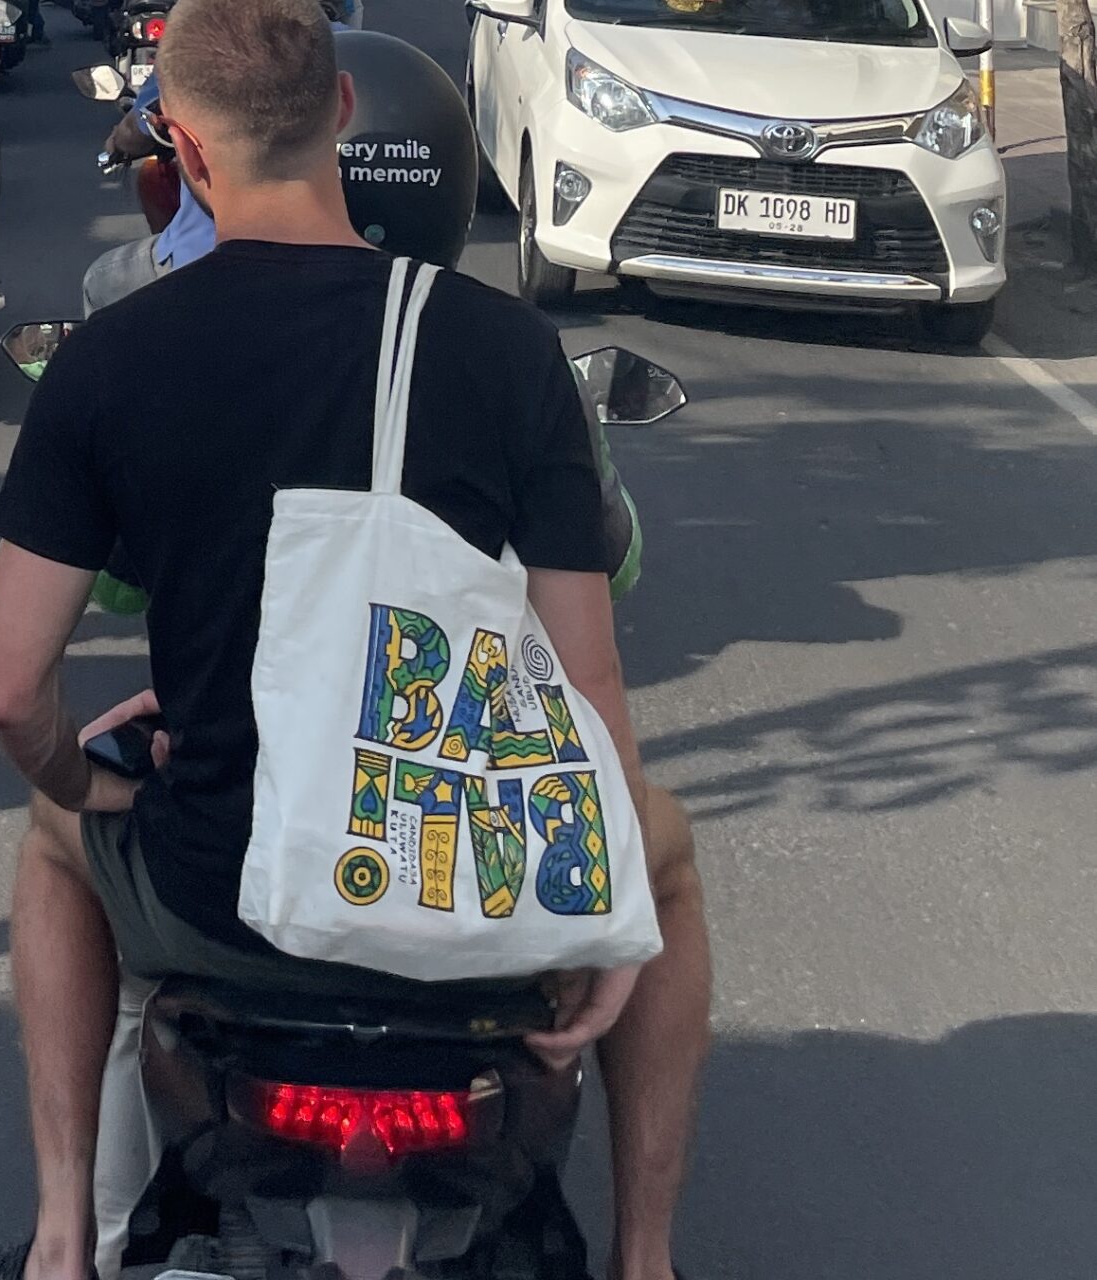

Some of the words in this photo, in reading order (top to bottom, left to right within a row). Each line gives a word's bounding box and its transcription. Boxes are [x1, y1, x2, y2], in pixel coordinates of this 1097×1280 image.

[384, 139, 431, 160] mile
[349, 166, 442, 187] memory
[724, 193, 749, 217] DK
[760, 196, 811, 221] 1098
[825, 201, 851, 225] HD
[354, 602, 591, 771] BALI
[390, 809, 399, 855] KUTA
[398, 813, 408, 884] ULUWATU
